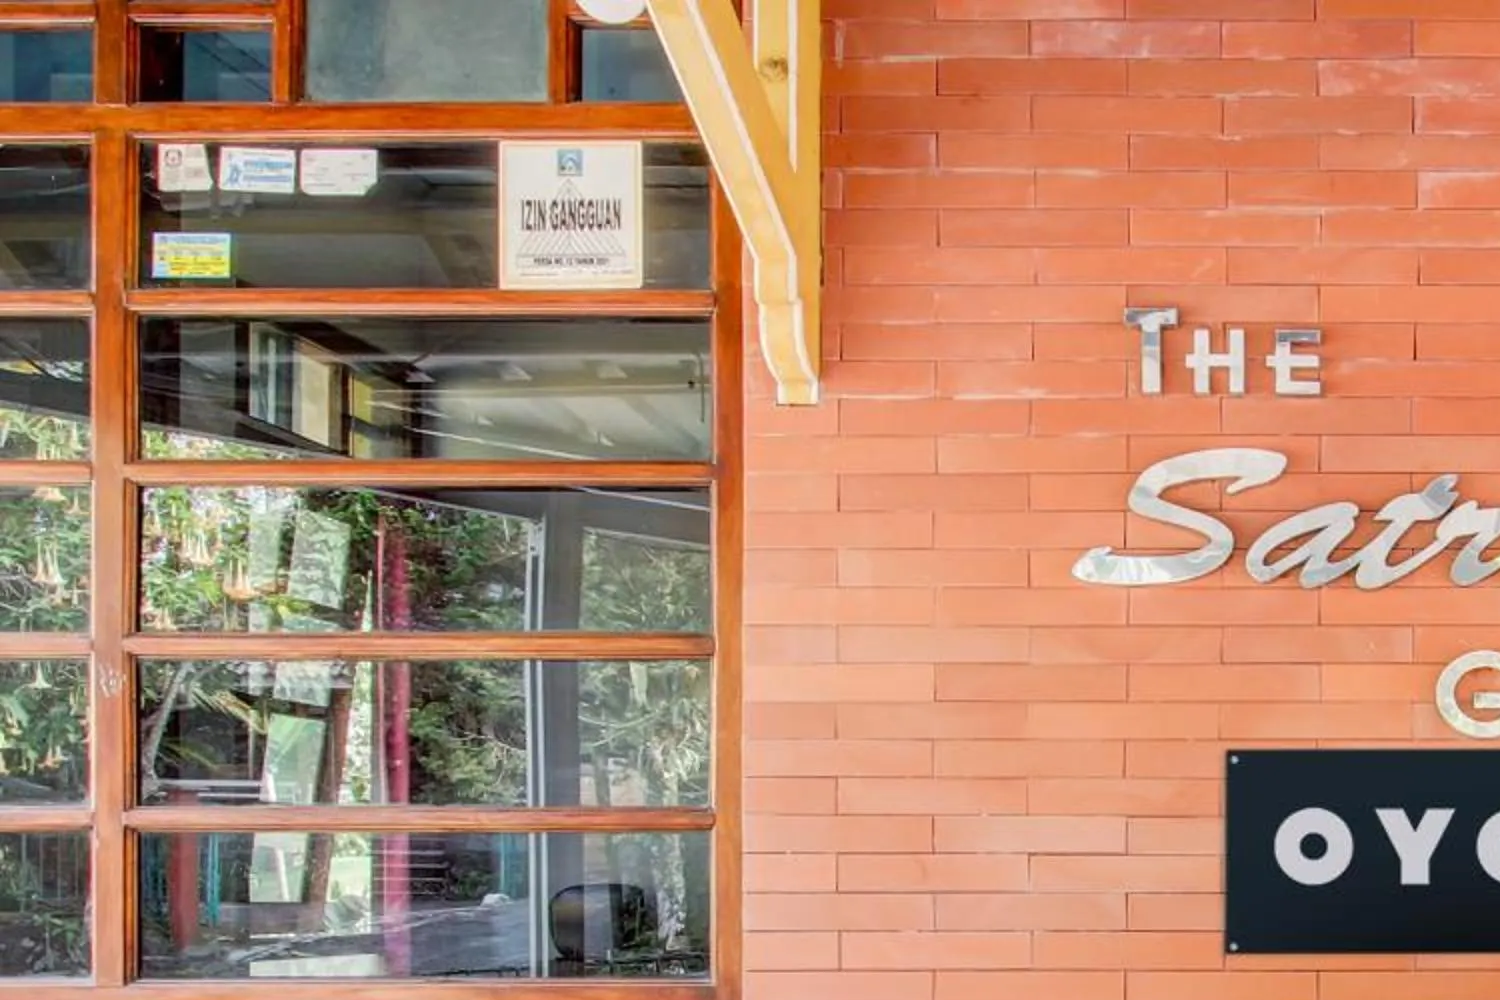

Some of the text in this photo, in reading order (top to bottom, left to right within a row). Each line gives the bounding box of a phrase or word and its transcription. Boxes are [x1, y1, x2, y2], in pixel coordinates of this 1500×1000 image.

[521, 198, 622, 231] IZIN GANGGUAN
[1123, 307, 1326, 397] THE
